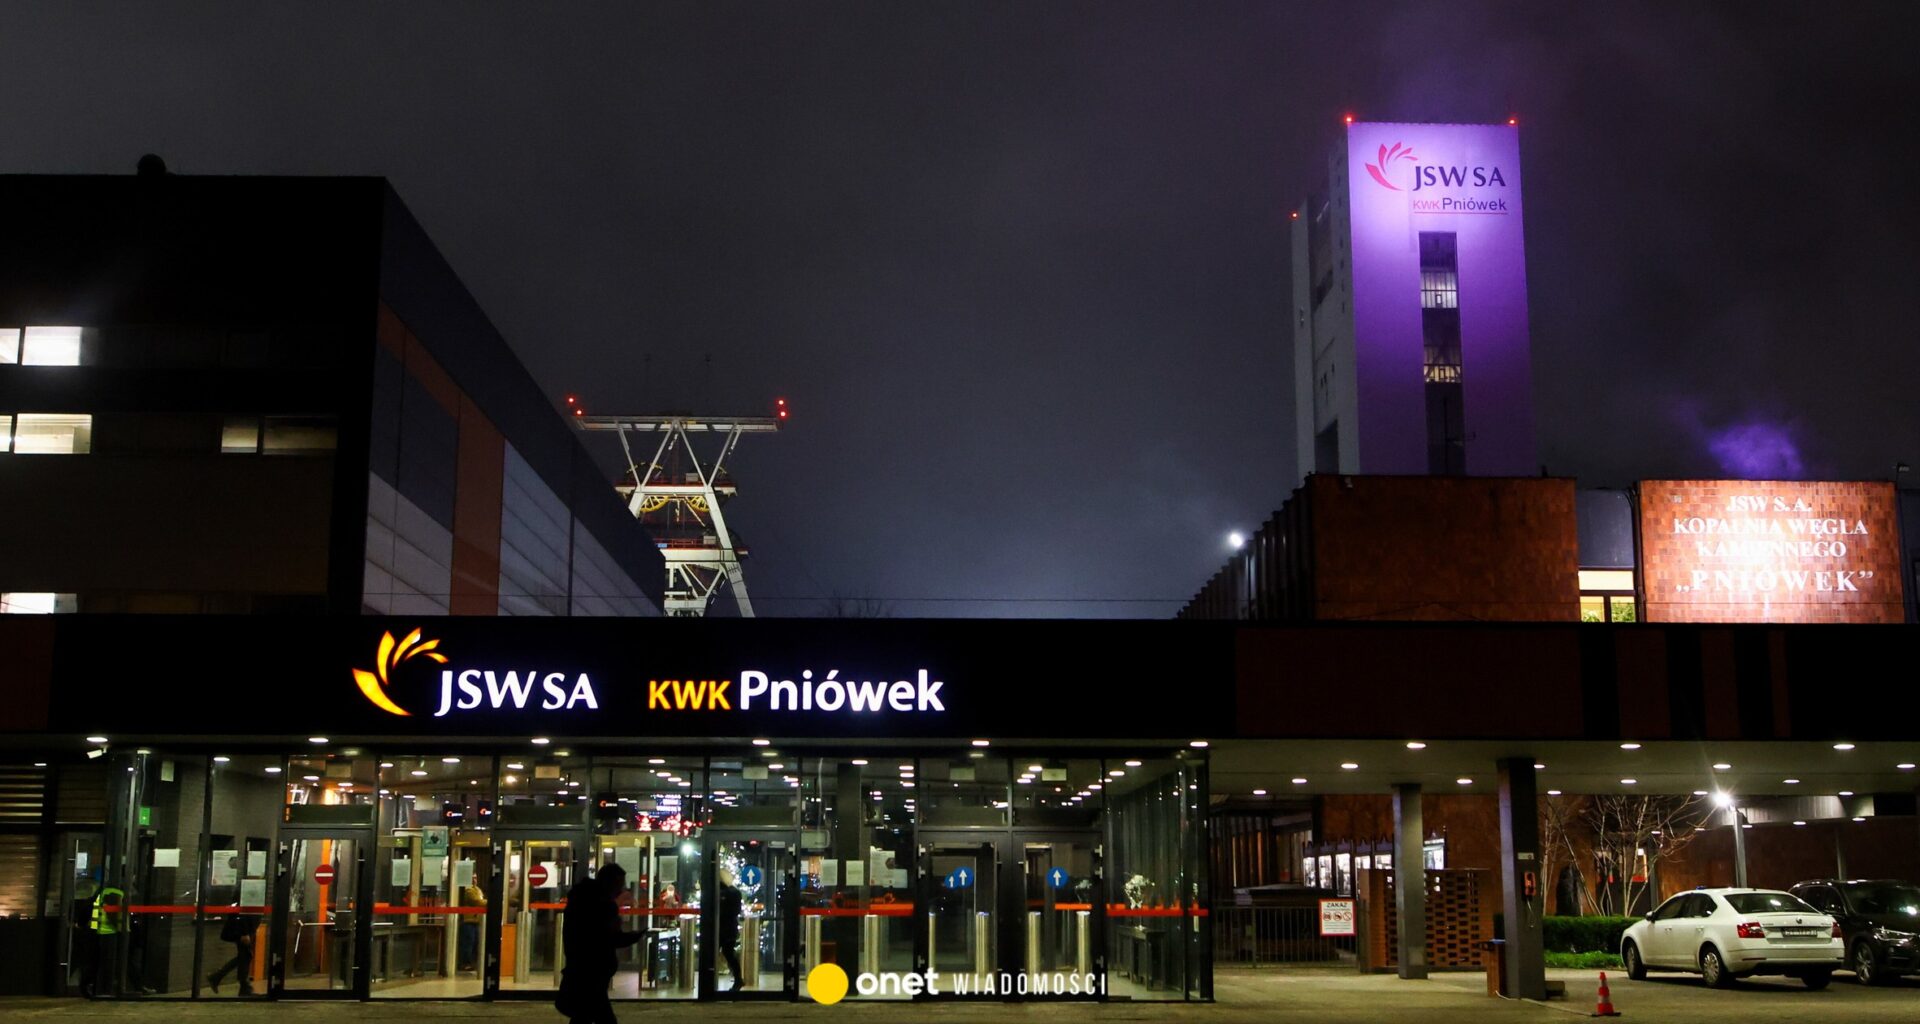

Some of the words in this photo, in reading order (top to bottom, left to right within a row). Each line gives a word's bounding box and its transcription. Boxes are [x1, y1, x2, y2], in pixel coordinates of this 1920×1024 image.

[1413, 166, 1468, 191] JSW
[1473, 167, 1506, 187] SA
[1413, 201, 1440, 210] KWK
[1442, 197, 1507, 211] Pniówek
[1727, 495, 1768, 512] JSW
[1673, 517, 1783, 534] KOPALNIA
[1786, 518, 1869, 538] WĘGLA
[434, 670, 537, 717] JSW
[543, 673, 599, 709] SA
[648, 680, 732, 711] KWK
[740, 668, 946, 712] Pniówek
